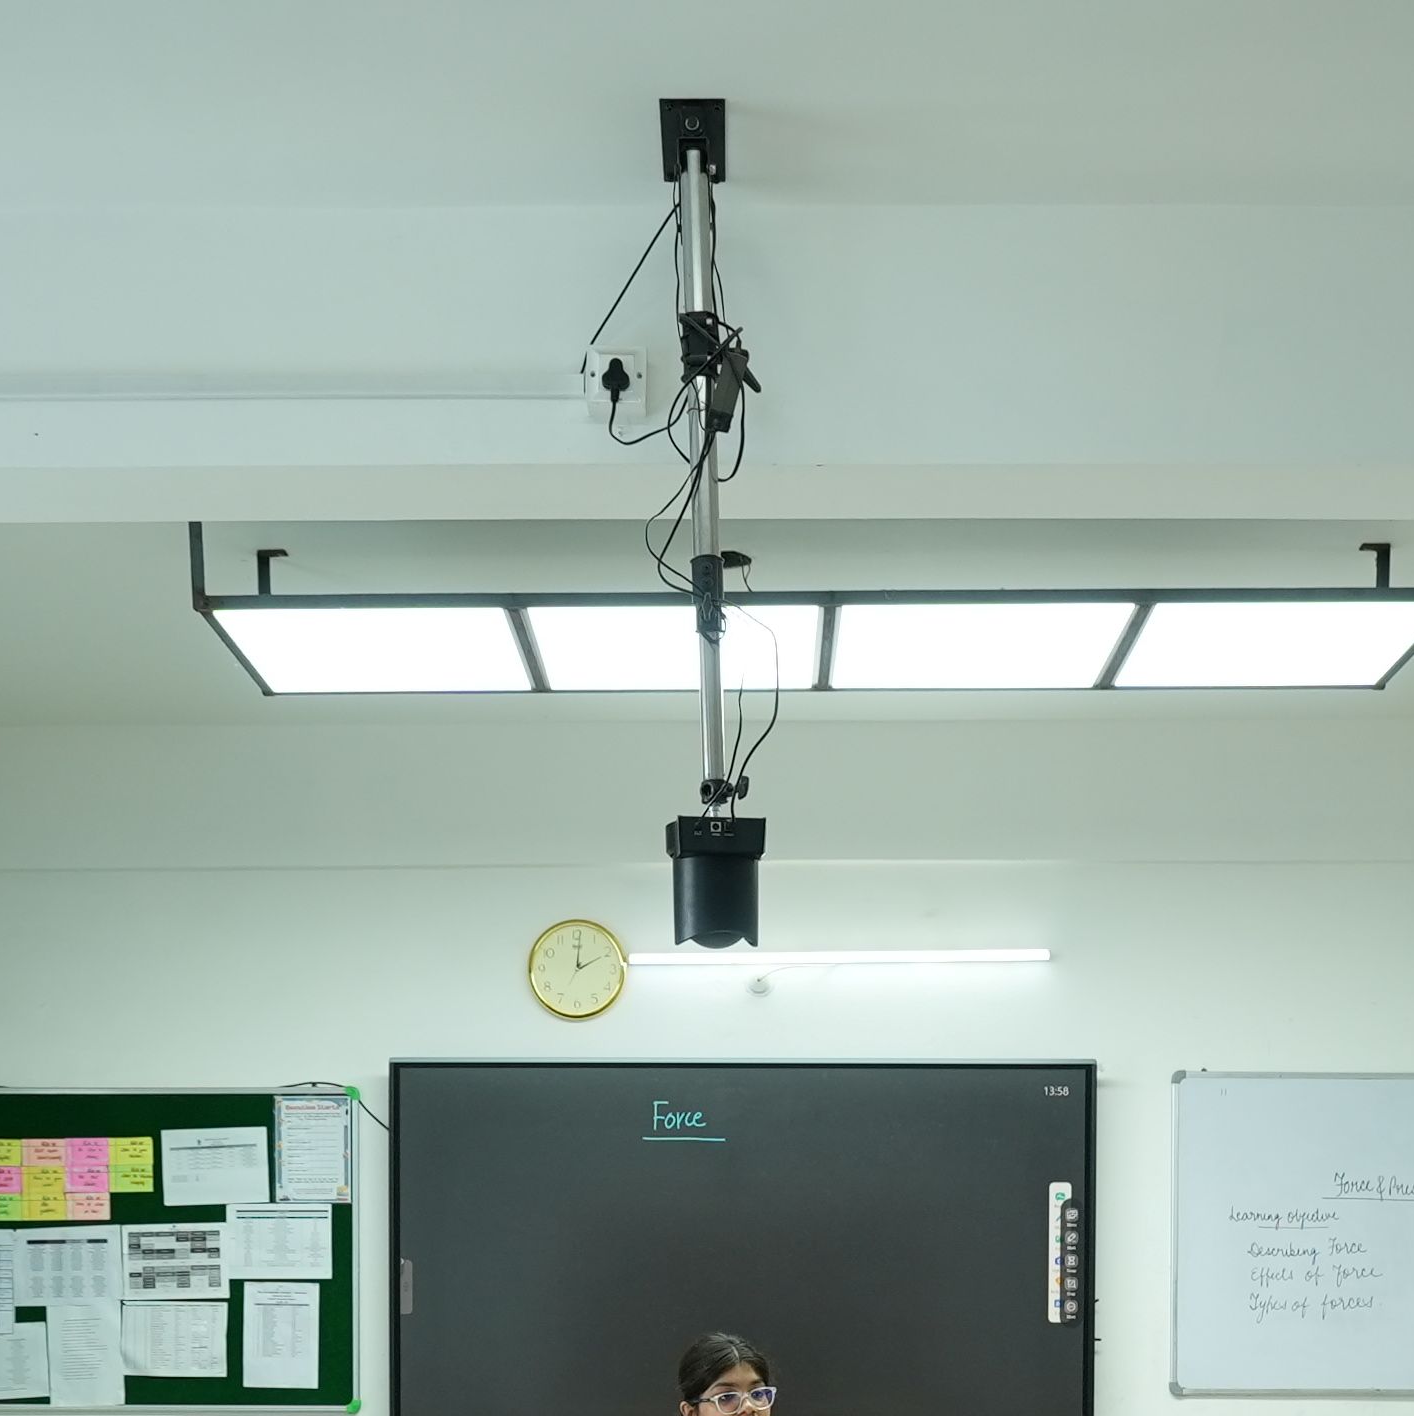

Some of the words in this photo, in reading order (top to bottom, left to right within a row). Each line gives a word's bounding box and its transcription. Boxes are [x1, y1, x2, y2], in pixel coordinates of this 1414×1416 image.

[604, 946, 611, 957] 2
[538, 964, 545, 973] 9
[610, 964, 616, 975] 3
[544, 981, 551, 992] 8
[604, 981, 611, 992] 4
[557, 992, 564, 1004] 7
[591, 993, 599, 1004] 5
[574, 1001, 581, 1009] 6
[1043, 1085, 1069, 1096] 13:58
[653, 1100, 707, 1130] Force
[1334, 1172, 1375, 1197] Force
[1376, 1175, 1386, 1201] &
[1229, 1205, 1282, 1230] Learning
[1247, 1242, 1320, 1265] Describing
[1329, 1237, 1368, 1256] Force
[1251, 1267, 1293, 1288] Effects
[1305, 1266, 1324, 1286] of
[1249, 1292, 1287, 1324] Types
[1291, 1296, 1309, 1319] of
